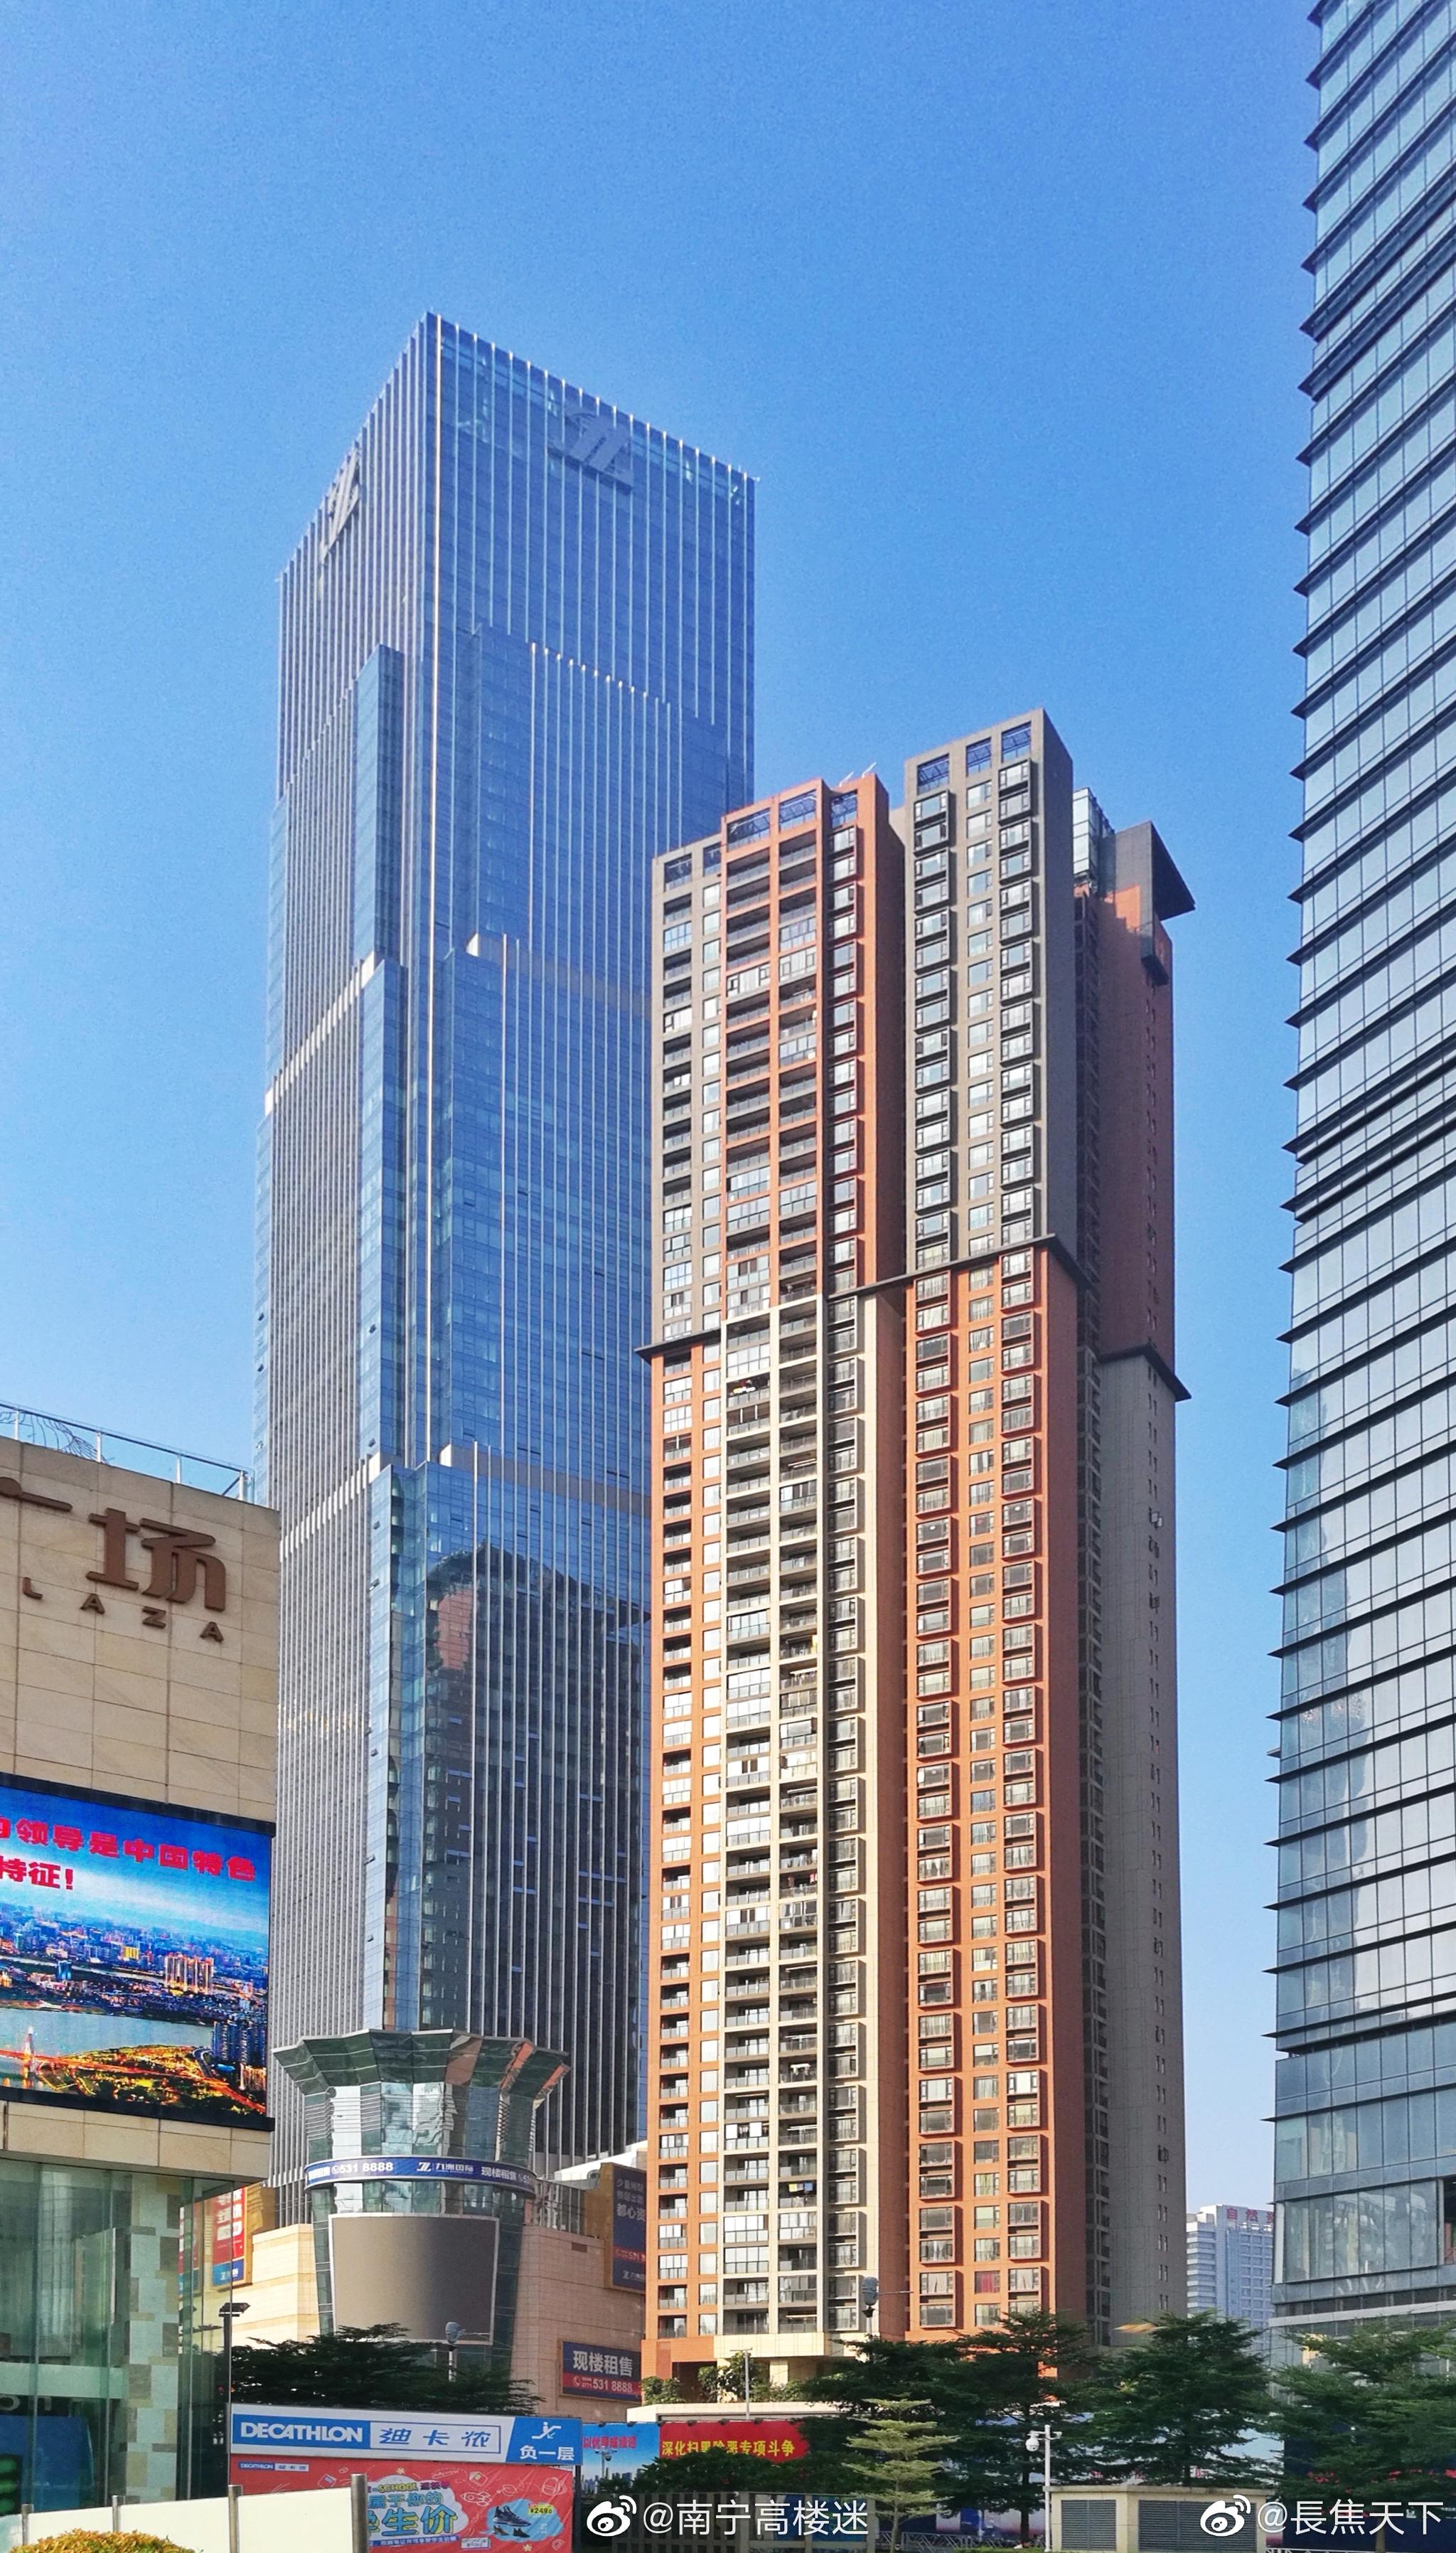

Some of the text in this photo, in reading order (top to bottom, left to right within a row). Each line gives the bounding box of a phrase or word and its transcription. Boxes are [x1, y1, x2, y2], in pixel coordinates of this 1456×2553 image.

[340, 2163, 358, 2173] 531
[363, 2162, 394, 2172] 8888
[572, 2350, 633, 2377] 现楼租售
[593, 2378, 609, 2390] 531
[611, 2380, 633, 2394] 8888
[240, 2421, 491, 2448] DECATHLON 迪卡侬
[520, 2445, 575, 2461] 负一层
[378, 2483, 418, 2493] SCHOOL
